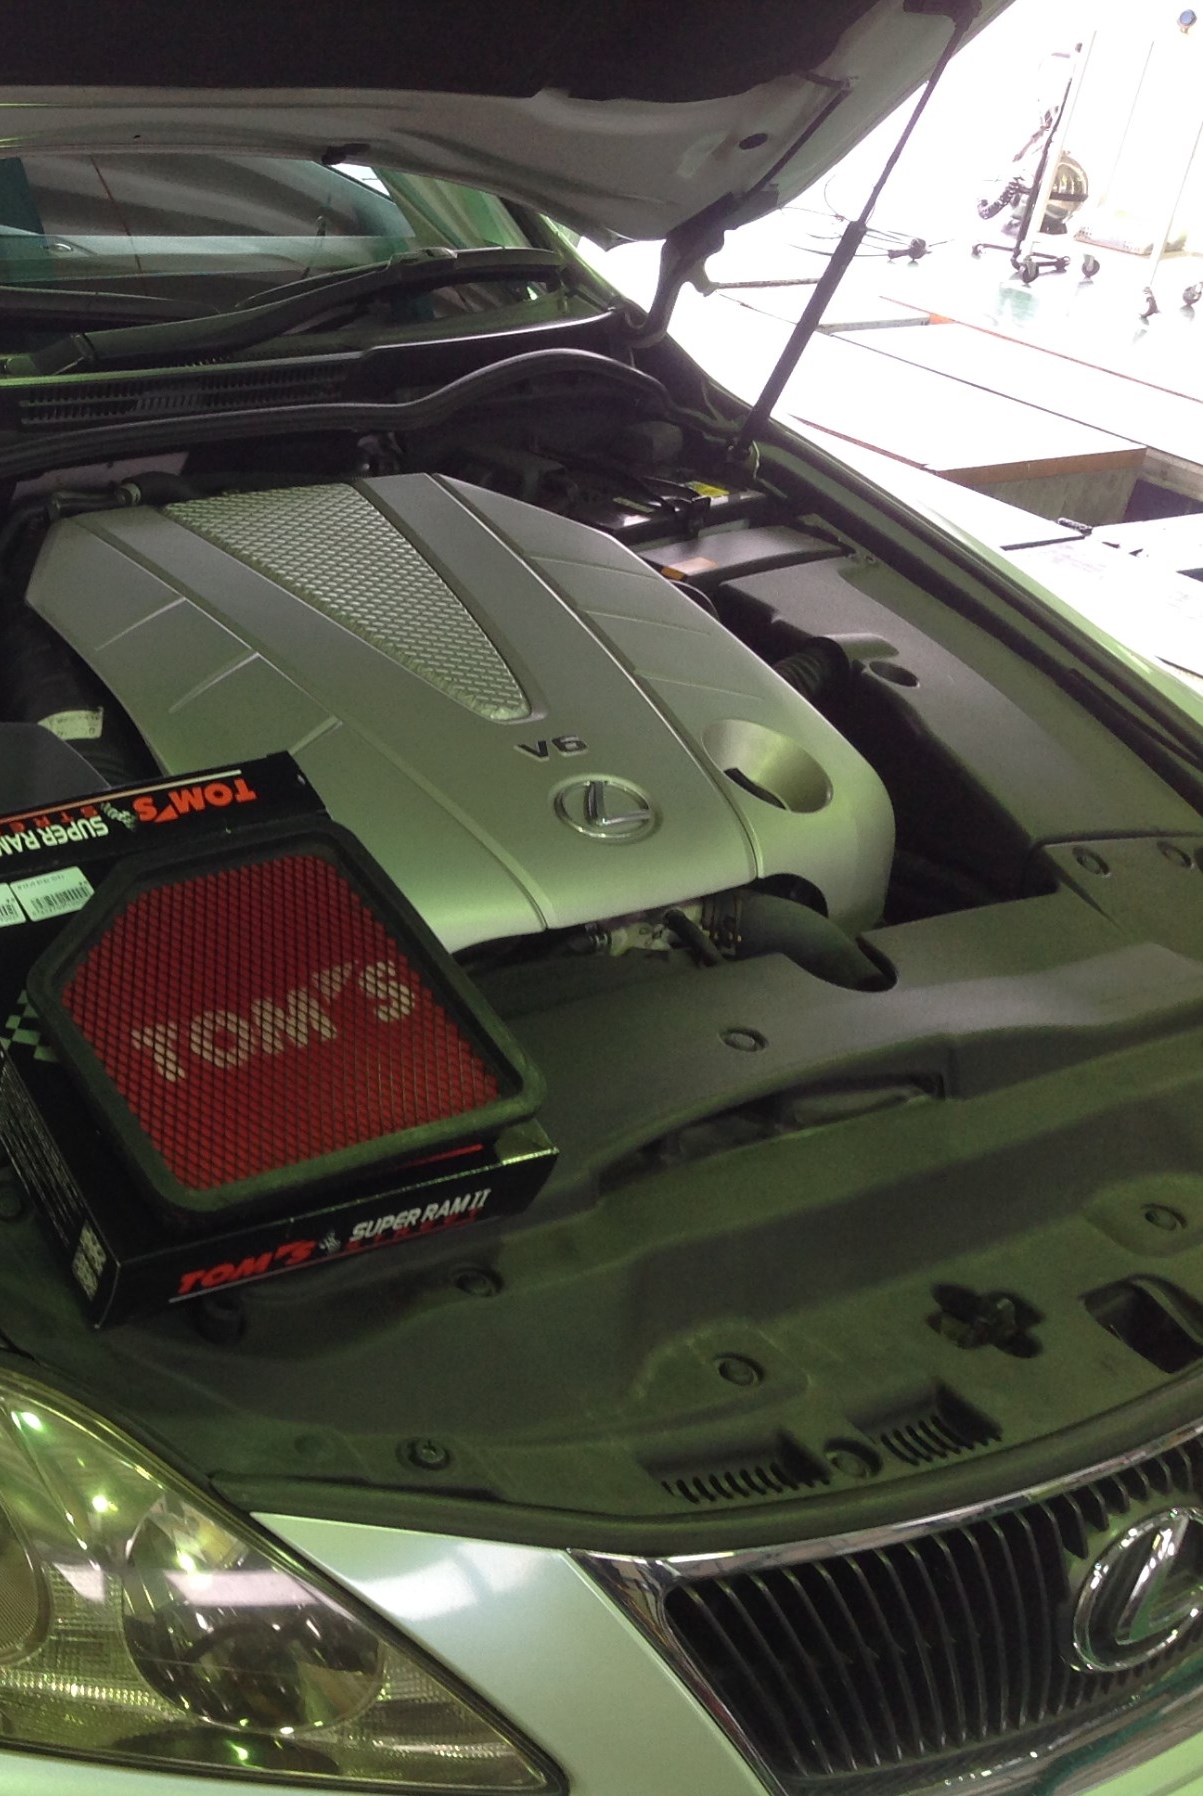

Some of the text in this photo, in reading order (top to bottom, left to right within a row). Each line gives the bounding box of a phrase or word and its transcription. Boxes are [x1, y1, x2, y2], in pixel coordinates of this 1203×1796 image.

[514, 734, 588, 762] V6
[132, 778, 258, 823] TOM'S
[37, 815, 109, 847] SUPER
[130, 960, 416, 1082] TOM'S
[177, 1239, 319, 1294] TOM'S
[349, 1206, 422, 1242] SUPER
[421, 1194, 471, 1223] RAM
